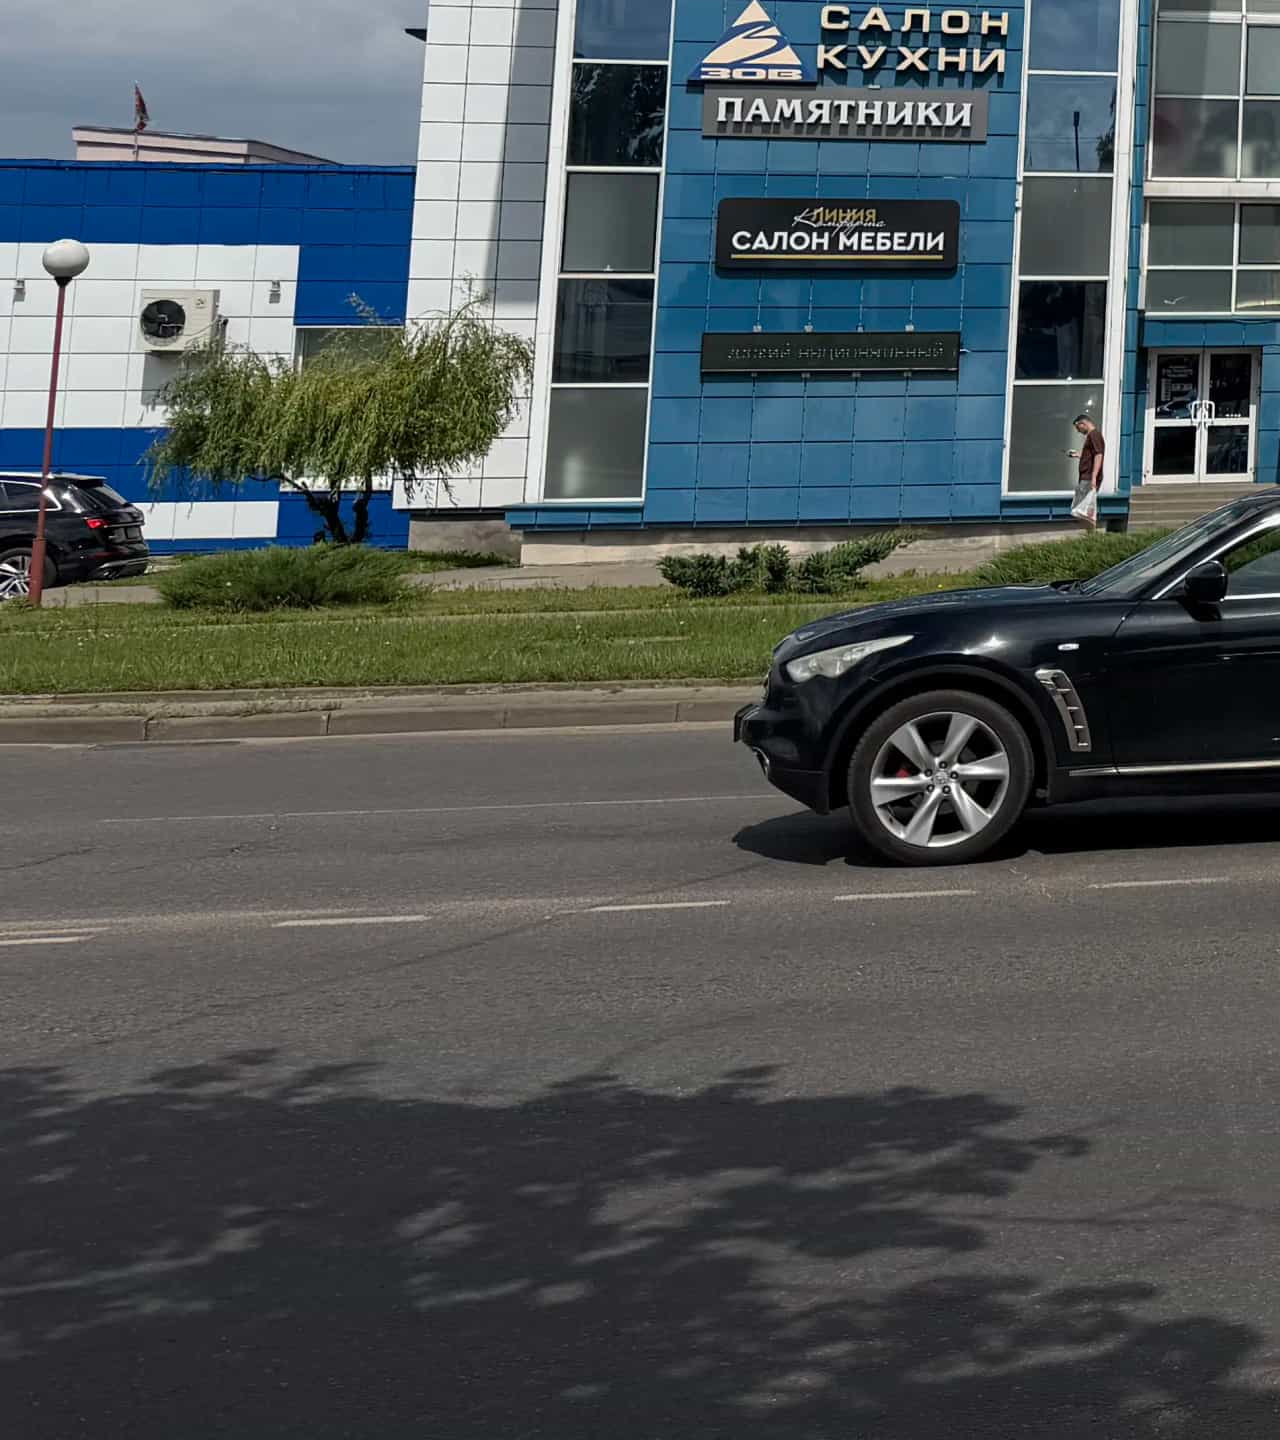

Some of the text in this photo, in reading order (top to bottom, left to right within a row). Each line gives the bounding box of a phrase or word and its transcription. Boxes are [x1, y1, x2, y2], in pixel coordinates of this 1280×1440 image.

[820, 5, 1009, 35] САЛОН
[817, 44, 1005, 72] КУХНИ
[701, 68, 802, 80] ЗОВ
[716, 97, 972, 127] ПАМЯТНИКИ
[732, 231, 944, 251] САЛОН МЕБЕЛИ
